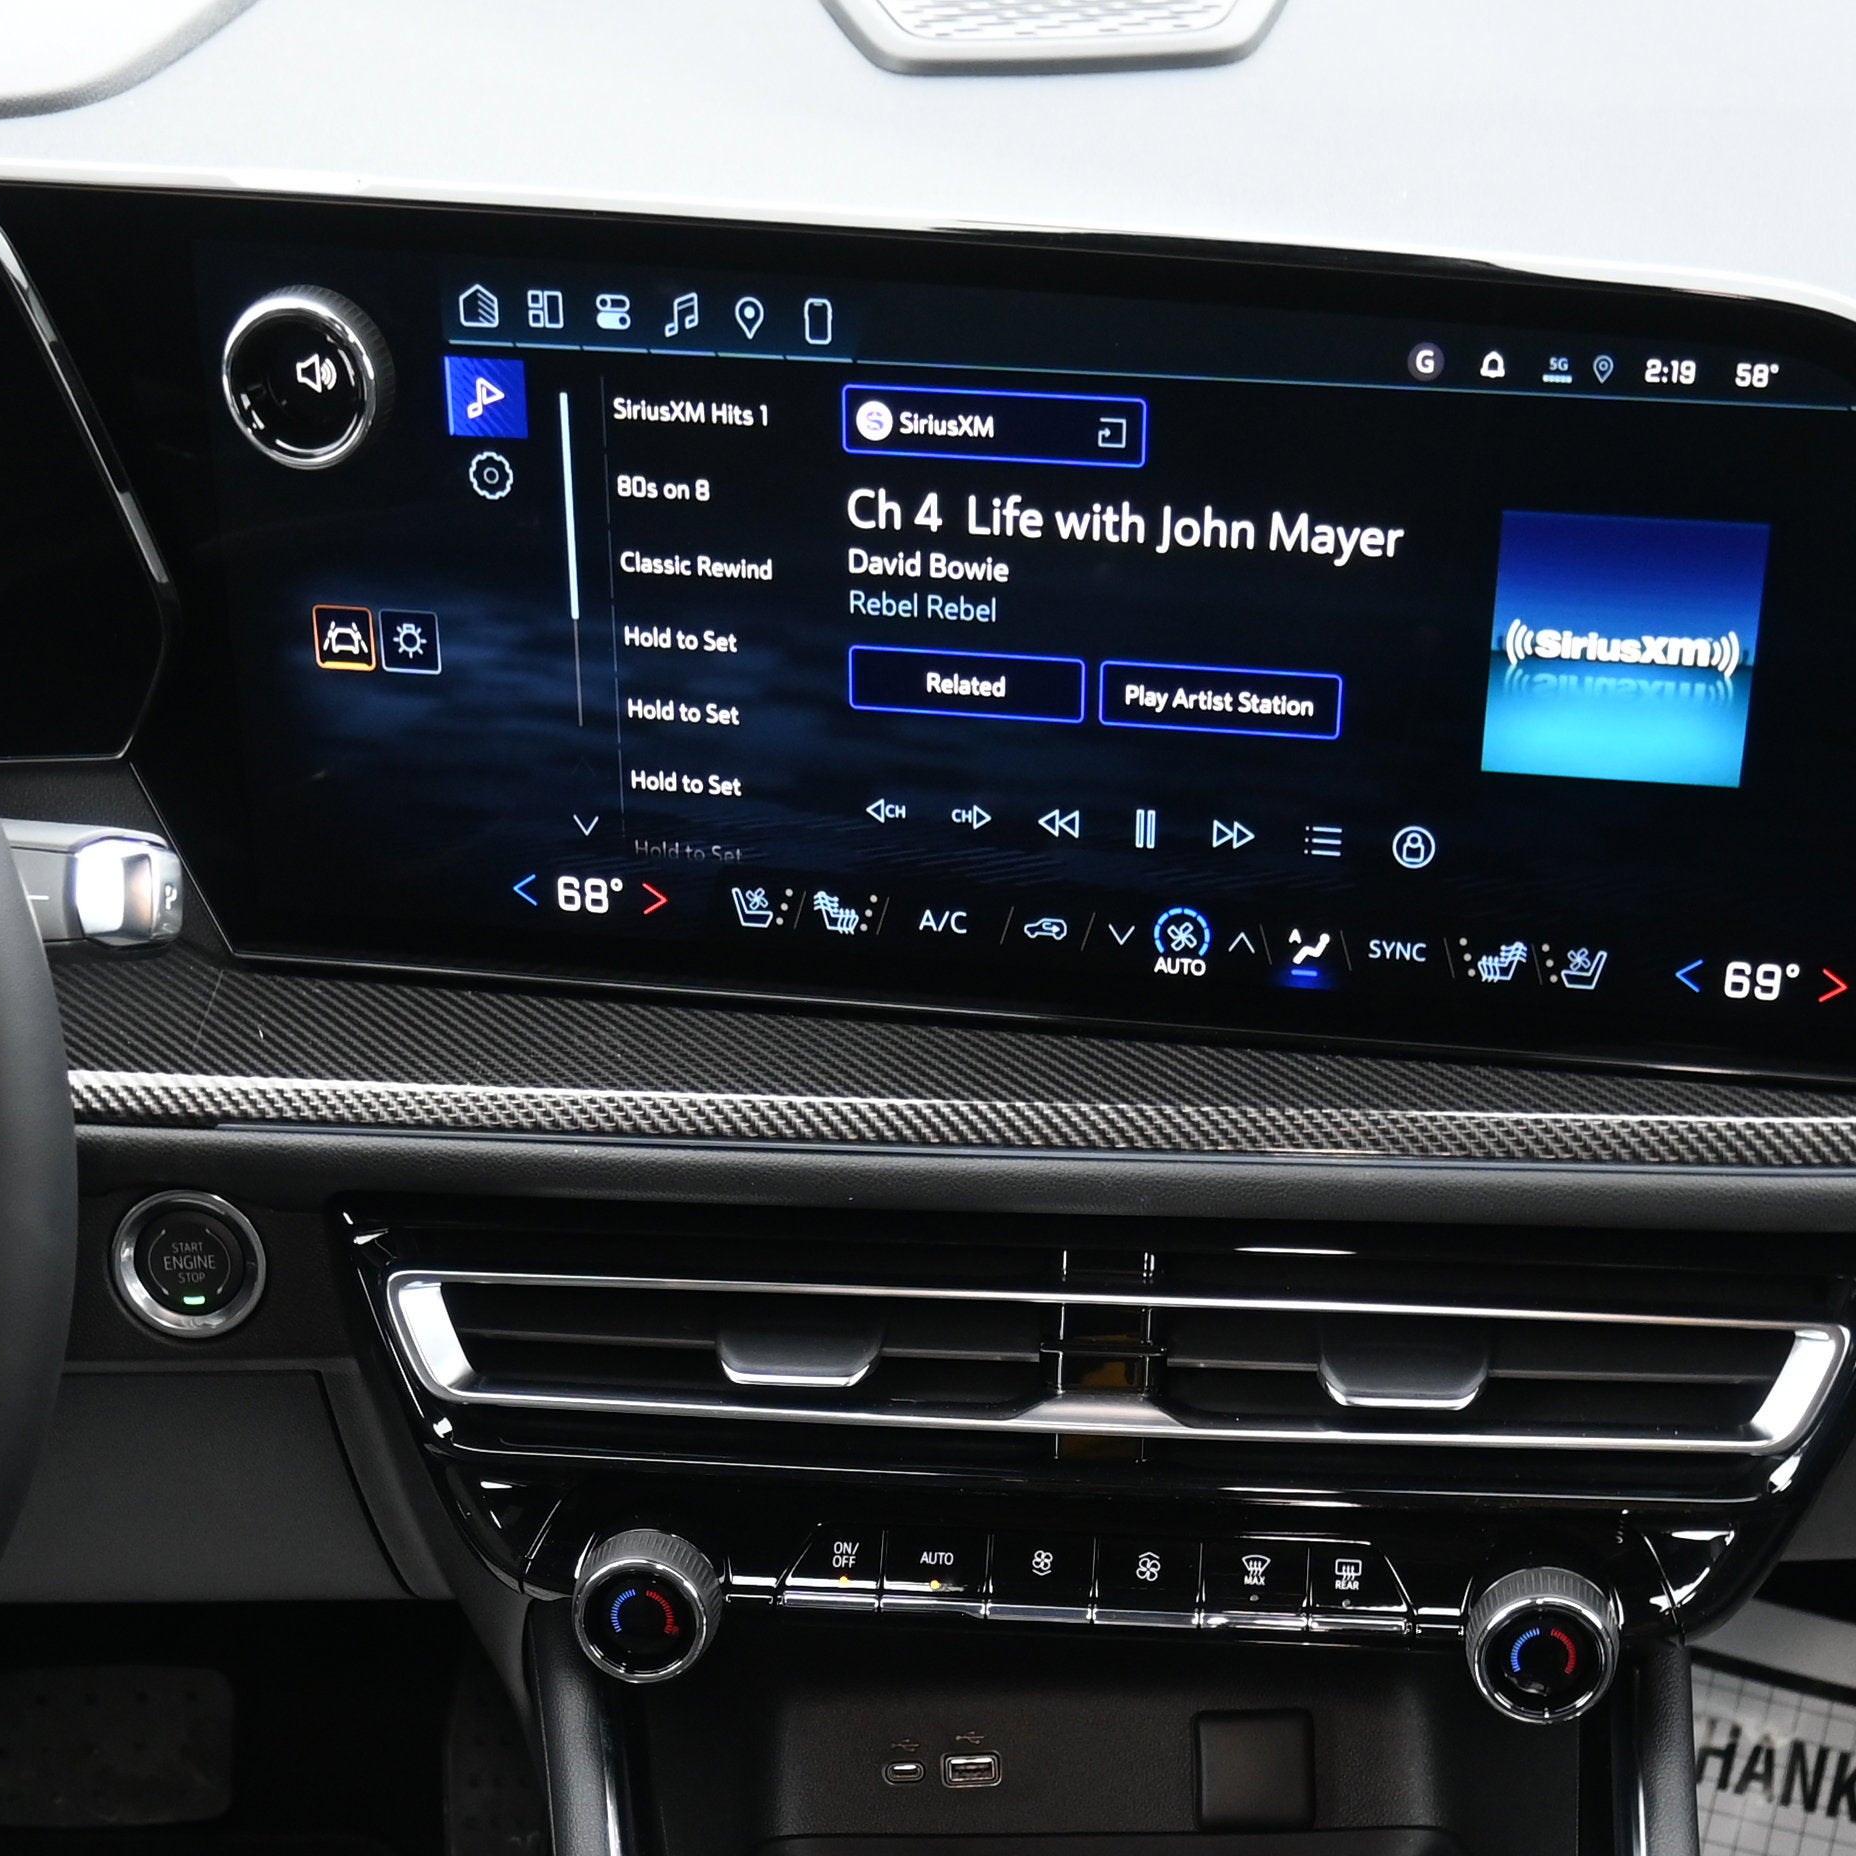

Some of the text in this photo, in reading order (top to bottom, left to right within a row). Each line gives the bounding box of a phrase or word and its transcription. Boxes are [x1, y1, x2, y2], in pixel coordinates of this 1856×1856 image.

[1415, 348, 1435, 374] G
[1549, 356, 1569, 372] 5G
[1644, 358, 1697, 385] 2:19
[1734, 362, 1780, 388] 58°
[613, 397, 768, 427] SiriusXM Hits 1
[899, 410, 995, 438] SiriusXM
[616, 474, 711, 502] 80s on 8
[847, 487, 1405, 567] Ch 4 Life with John Mayer
[619, 550, 773, 581] Classic Rewind
[848, 547, 1010, 583] David Bowie
[849, 589, 997, 623] Rebel Rebel
[623, 625, 738, 653] Hold to Set
[926, 671, 1006, 698] Related
[627, 697, 740, 726] Hold to Set
[1125, 683, 1314, 717] Play Artist Station
[630, 769, 742, 797] Hold to Set
[885, 803, 907, 820] CH
[951, 808, 973, 824] CH
[557, 875, 624, 914] 68°
[918, 909, 968, 934] A/C
[1368, 939, 1427, 962] SYNC
[1153, 955, 1207, 977] AUTO
[1724, 960, 1801, 1001] 69°
[171, 1241, 203, 1254] START
[163, 1254, 216, 1271] ENGINE
[178, 1271, 206, 1284] STOP
[832, 1554, 856, 1568] OFF
[833, 1541, 860, 1555] ON/
[919, 1551, 954, 1566] AUTO
[1243, 1570, 1266, 1586] MAX
[1334, 1575, 1360, 1591] REAR
